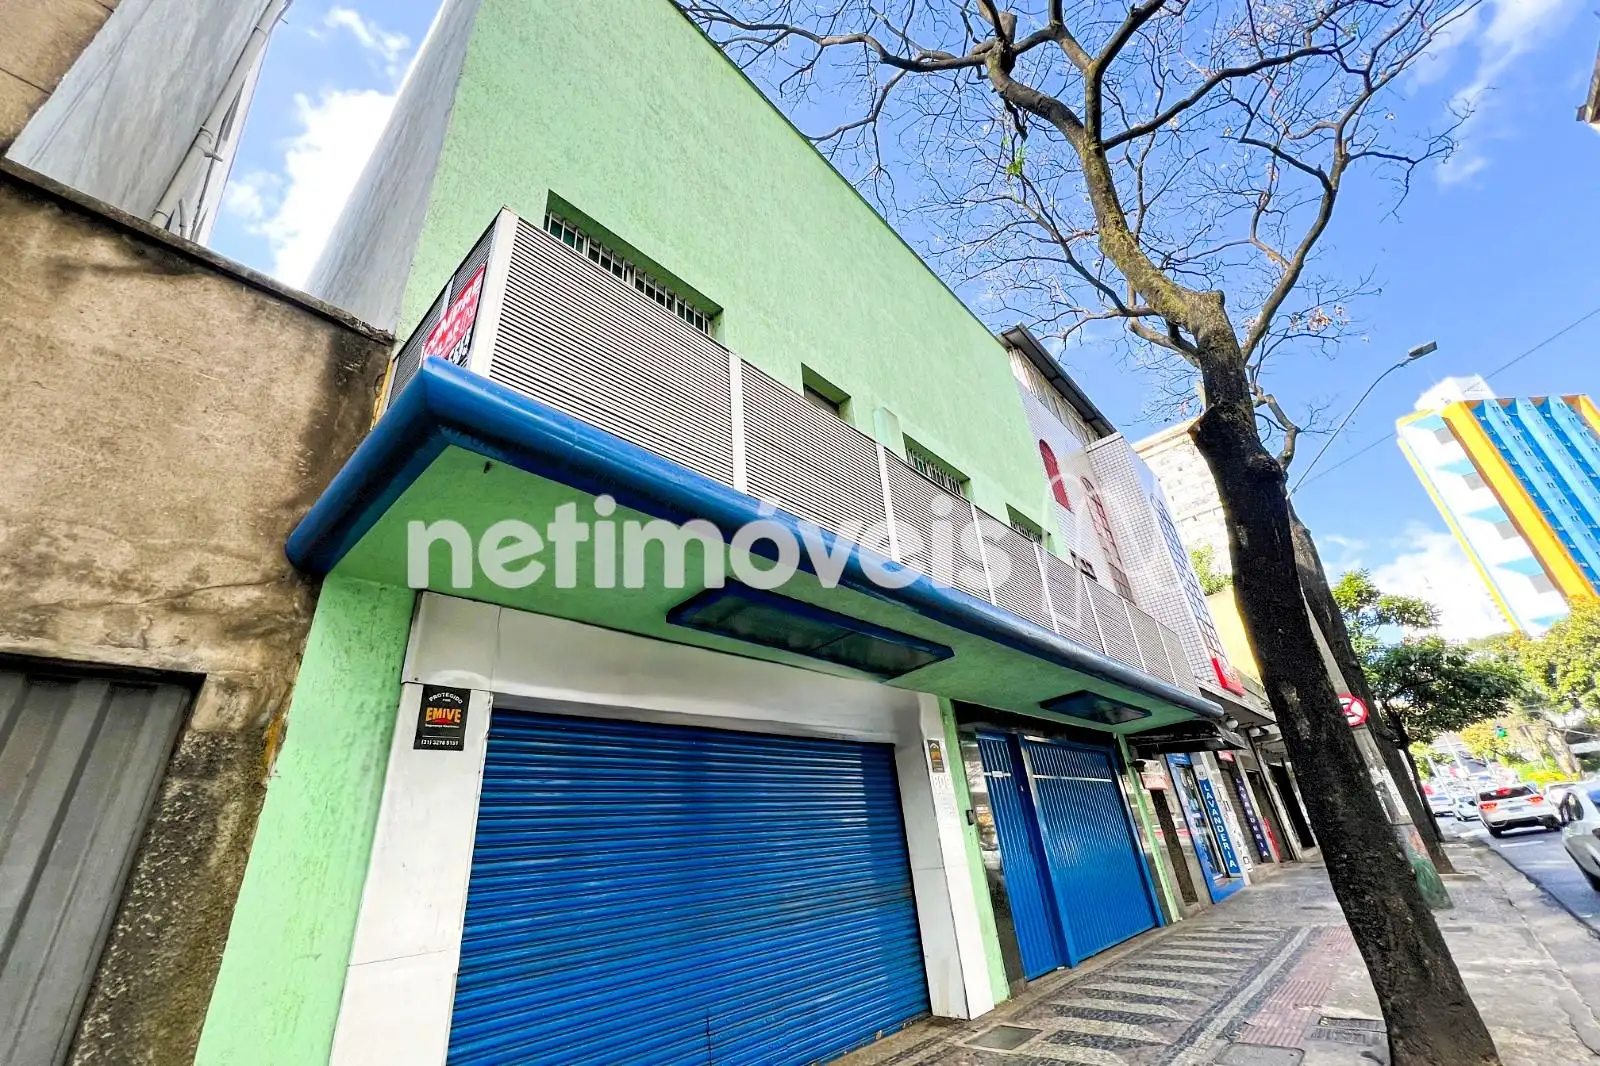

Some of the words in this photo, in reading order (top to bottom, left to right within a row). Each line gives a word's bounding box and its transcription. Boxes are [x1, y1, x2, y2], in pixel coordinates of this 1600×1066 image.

[425, 707, 462, 723] EMIVE
[429, 692, 463, 704] PROTEGIDO
[1203, 784, 1237, 868] LAVANDERIA
[1236, 778, 1269, 857] LAVANDERIA
